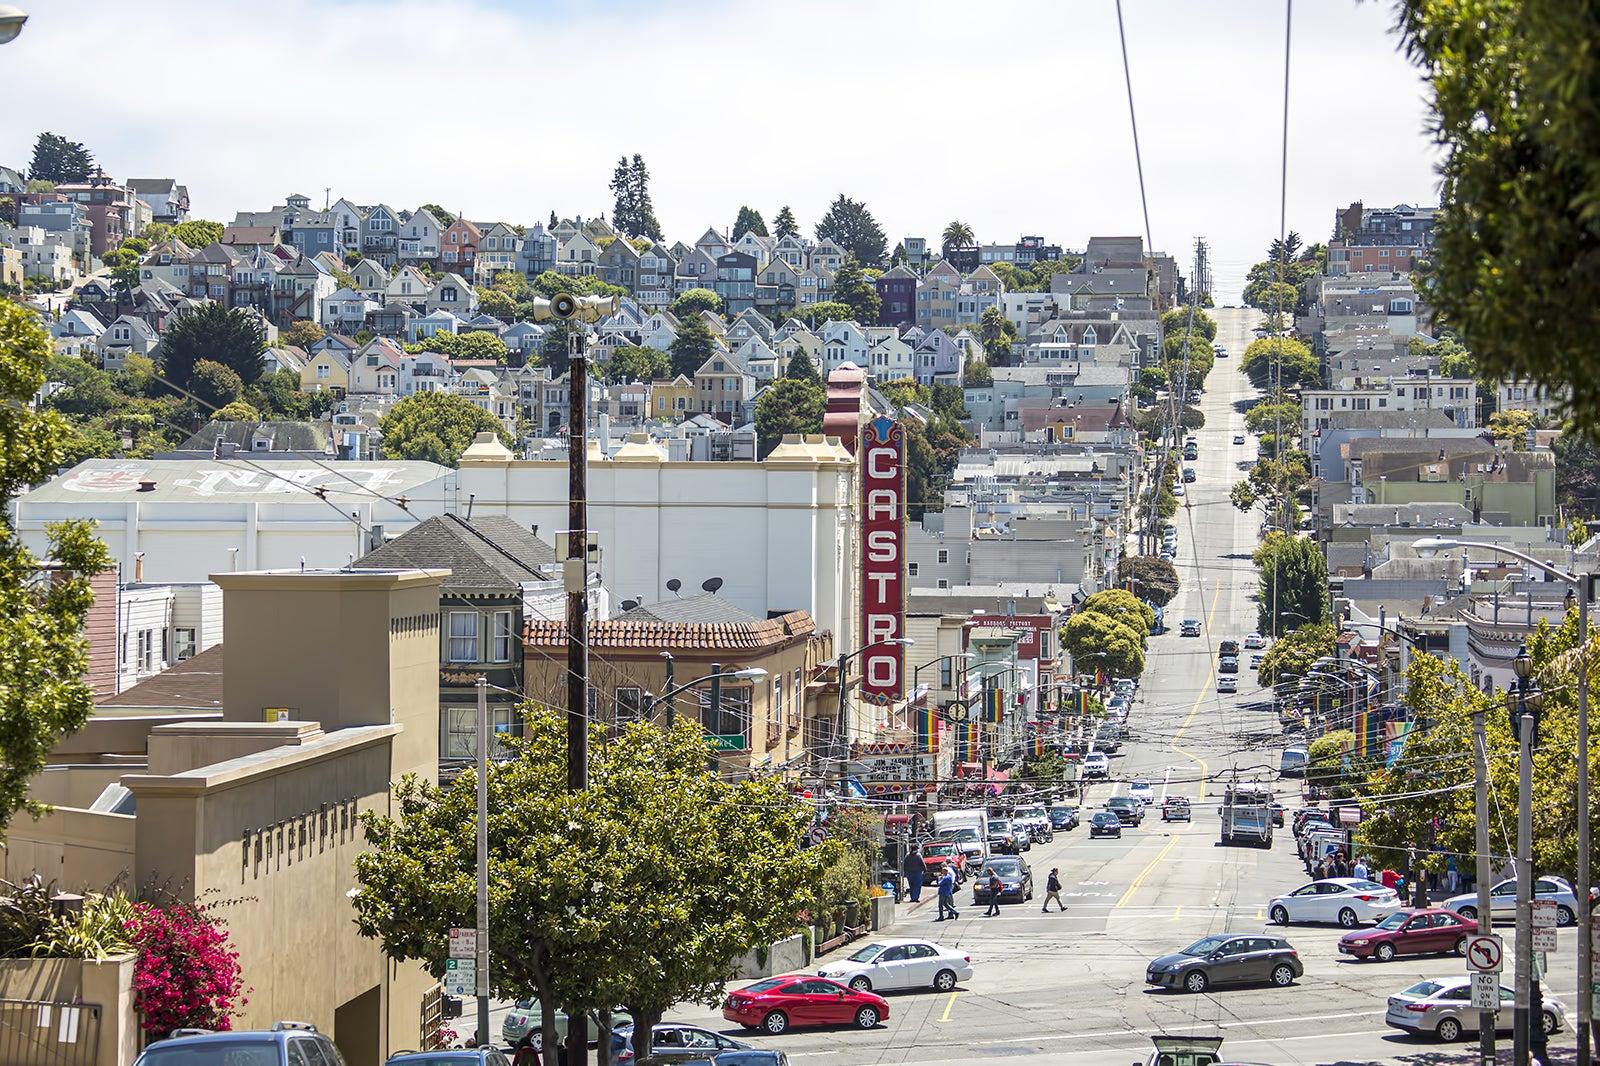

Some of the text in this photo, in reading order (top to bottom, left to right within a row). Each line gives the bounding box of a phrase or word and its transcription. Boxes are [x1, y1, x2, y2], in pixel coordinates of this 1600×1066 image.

[868, 447, 896, 687] CASTRO
[449, 961, 456, 969] 2
[1478, 975, 1493, 985] NO
[1476, 984, 1494, 992] TURN
[1478, 1000, 1492, 1008] RED
